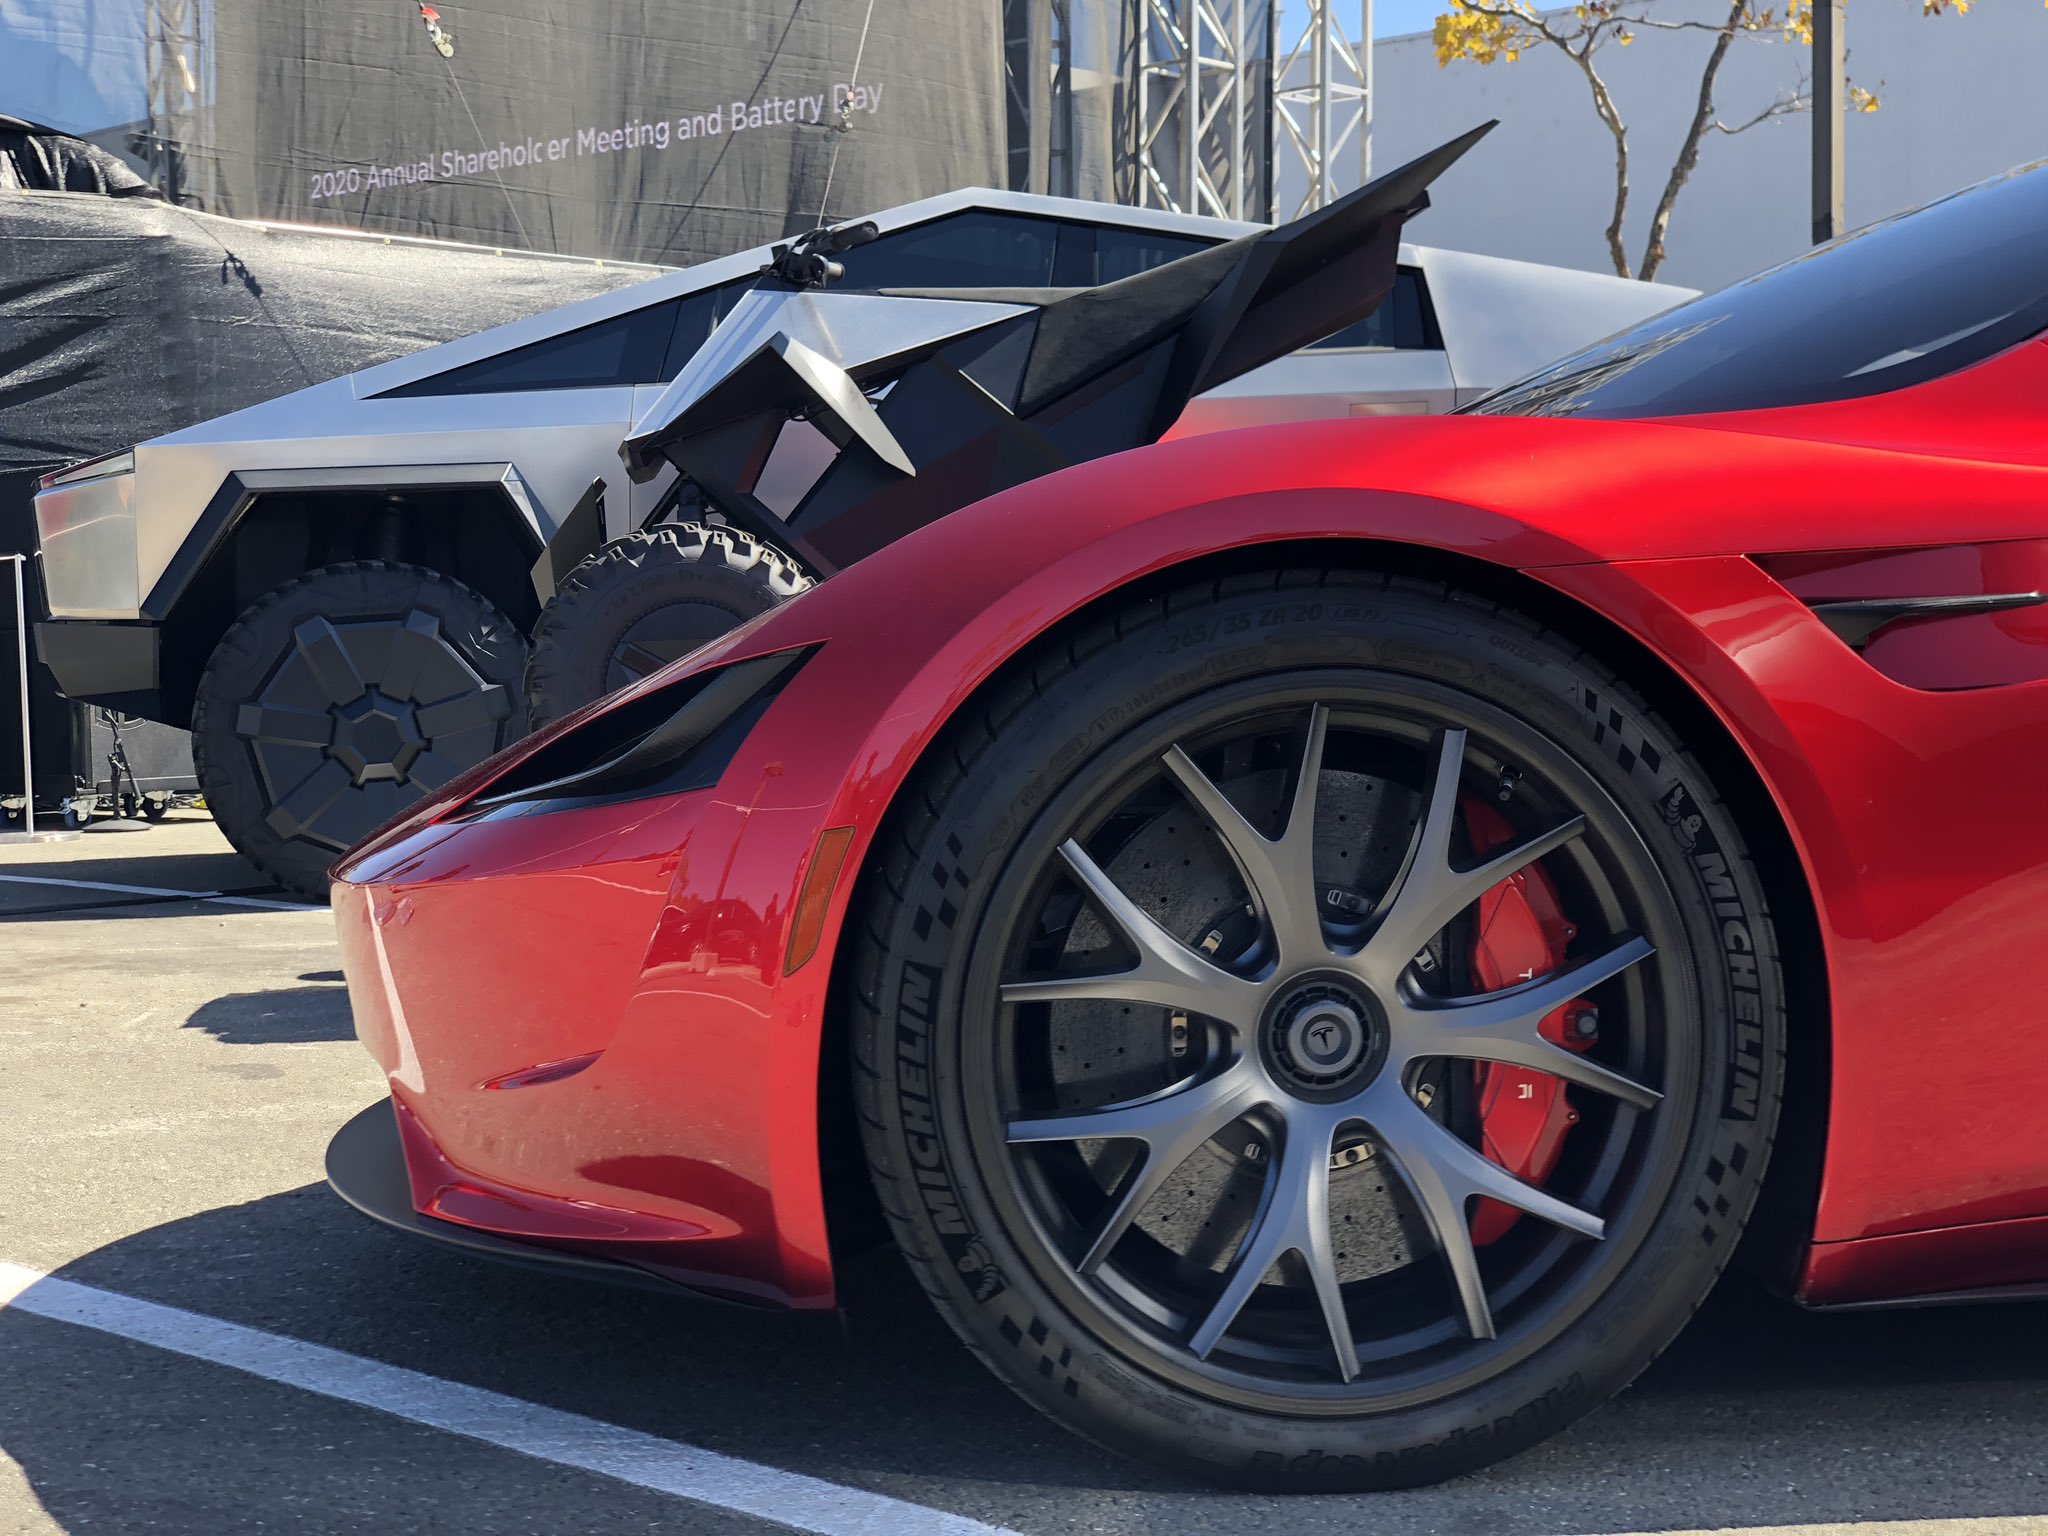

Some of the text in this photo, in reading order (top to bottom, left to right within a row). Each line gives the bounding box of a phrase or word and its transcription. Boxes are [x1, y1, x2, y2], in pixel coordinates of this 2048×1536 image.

[311, 168, 360, 199] 2020
[366, 154, 434, 190] Annual
[577, 119, 670, 156] Meeting
[677, 105, 722, 141] and
[731, 94, 824, 131] Battery
[833, 83, 883, 114] Day
[1295, 603, 1323, 622] 20
[1695, 852, 1761, 1117] MICHELIN
[897, 964, 968, 1234] MICHELIN
